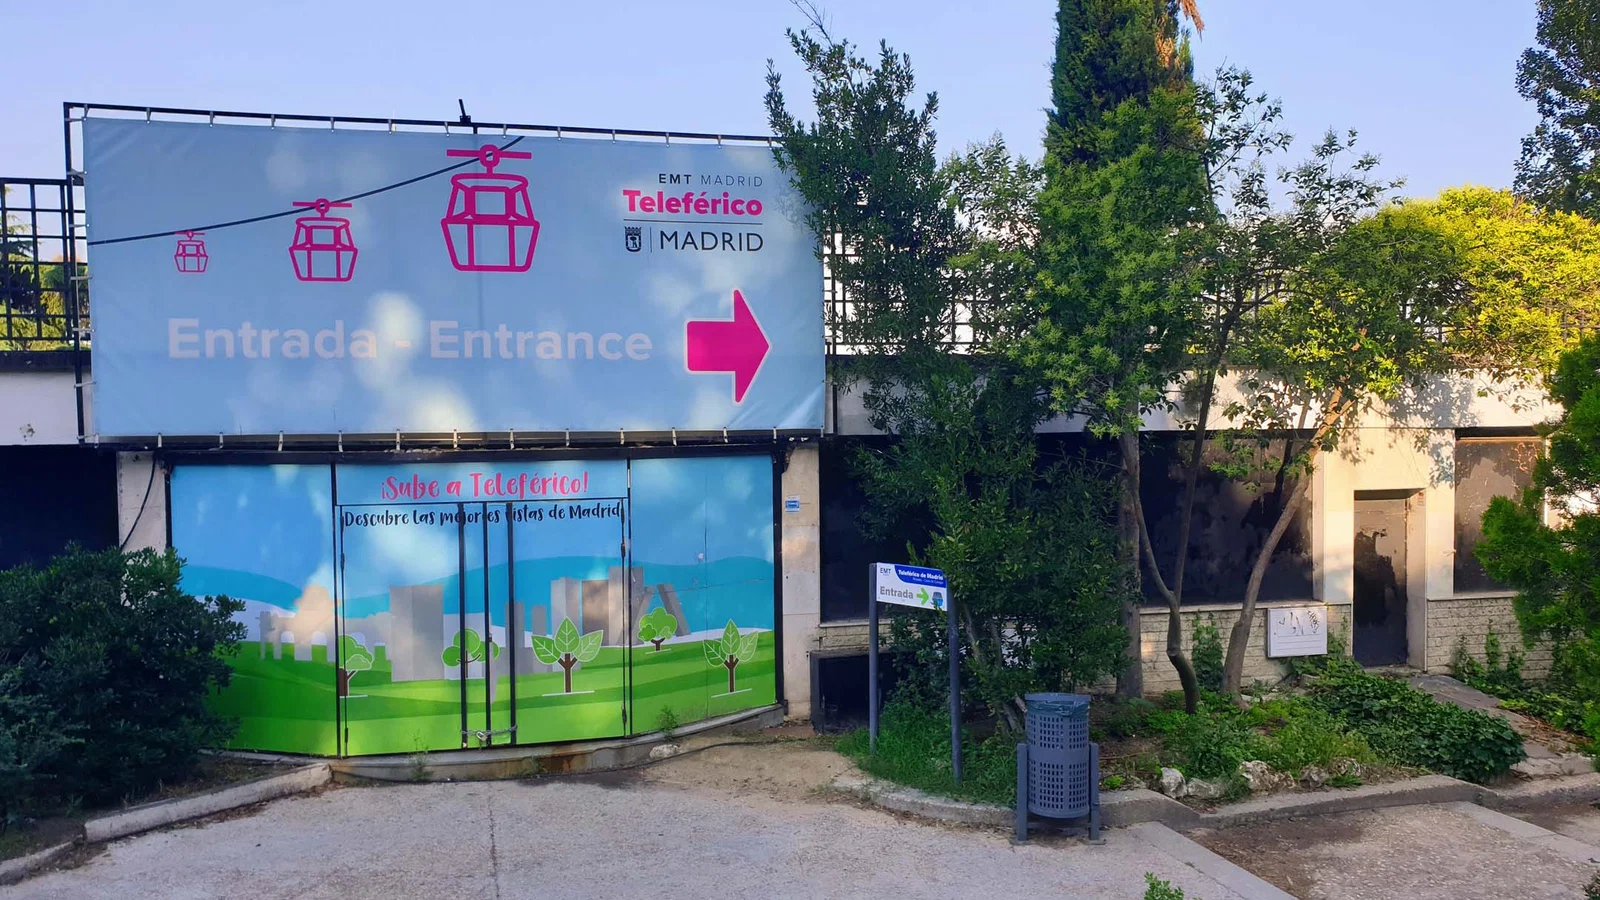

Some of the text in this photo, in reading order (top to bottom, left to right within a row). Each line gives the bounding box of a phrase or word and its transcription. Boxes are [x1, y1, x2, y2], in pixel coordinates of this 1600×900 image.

[658, 173, 763, 187] EMT MADRID
[622, 189, 763, 216] Teleférico
[660, 230, 764, 252] MADRID
[168, 318, 377, 359] Entrada
[429, 320, 653, 360] Entrance
[381, 471, 589, 500] ¡Sube a Teleférico!
[345, 509, 409, 527] Descubre
[413, 509, 435, 525] las
[548, 504, 566, 520] de
[569, 501, 621, 520] Madrid
[880, 586, 914, 599] Entrada
